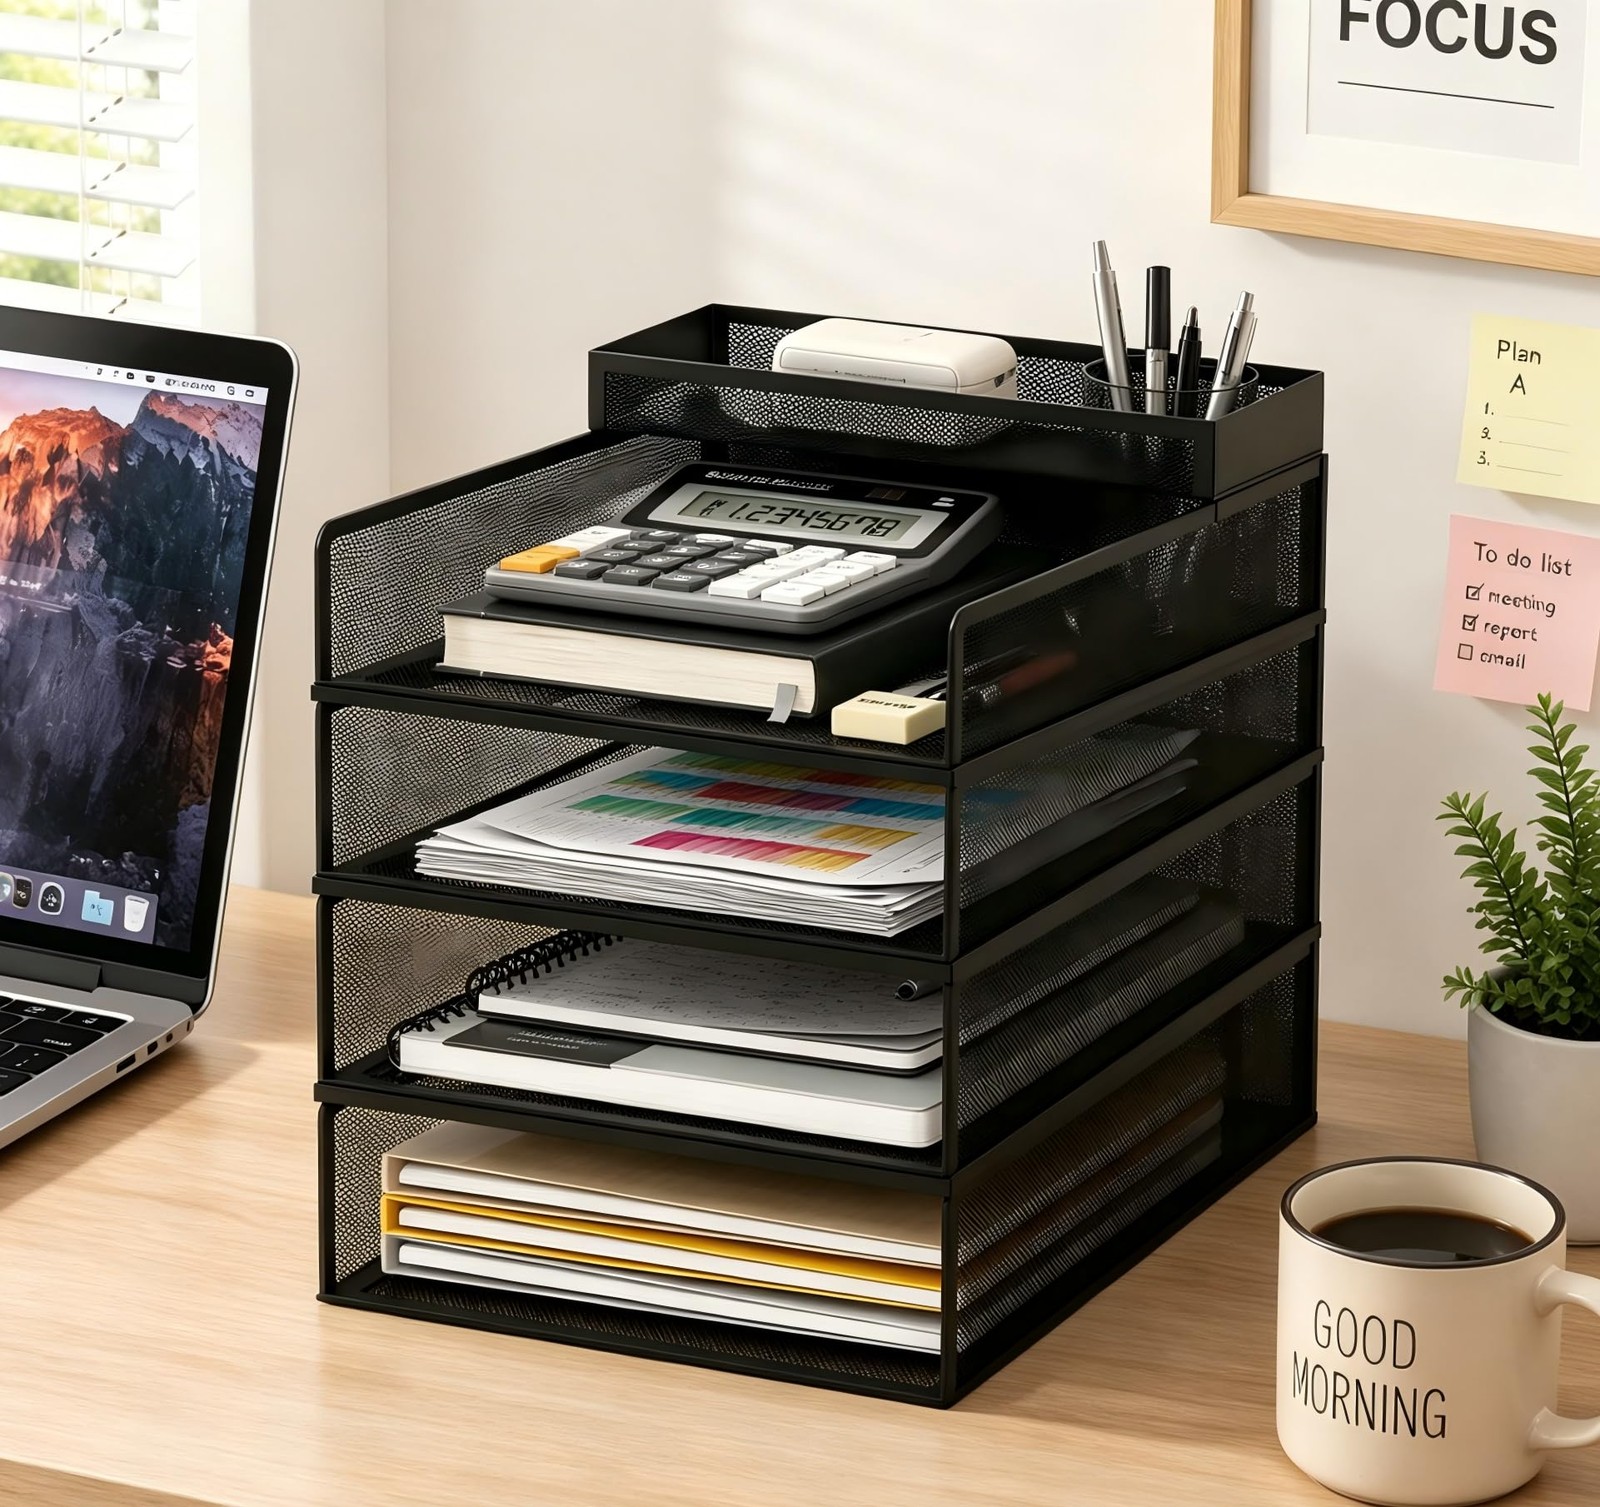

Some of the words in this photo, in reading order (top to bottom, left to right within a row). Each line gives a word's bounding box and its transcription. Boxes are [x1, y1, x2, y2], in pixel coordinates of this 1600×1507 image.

[1339, 0, 1557, 64] FOCUS
[1497, 339, 1541, 365] Plan
[1509, 373, 1526, 395] A
[1484, 402, 1494, 415] 1.
[1477, 450, 1490, 466] 3.
[1473, 541, 1498, 563] To
[1507, 548, 1531, 569] do
[1541, 552, 1572, 576] list
[1488, 591, 1556, 618] meeting
[1484, 621, 1538, 641] report
[1314, 1299, 1416, 1370] GOOD
[1293, 1350, 1446, 1439] MORNING
